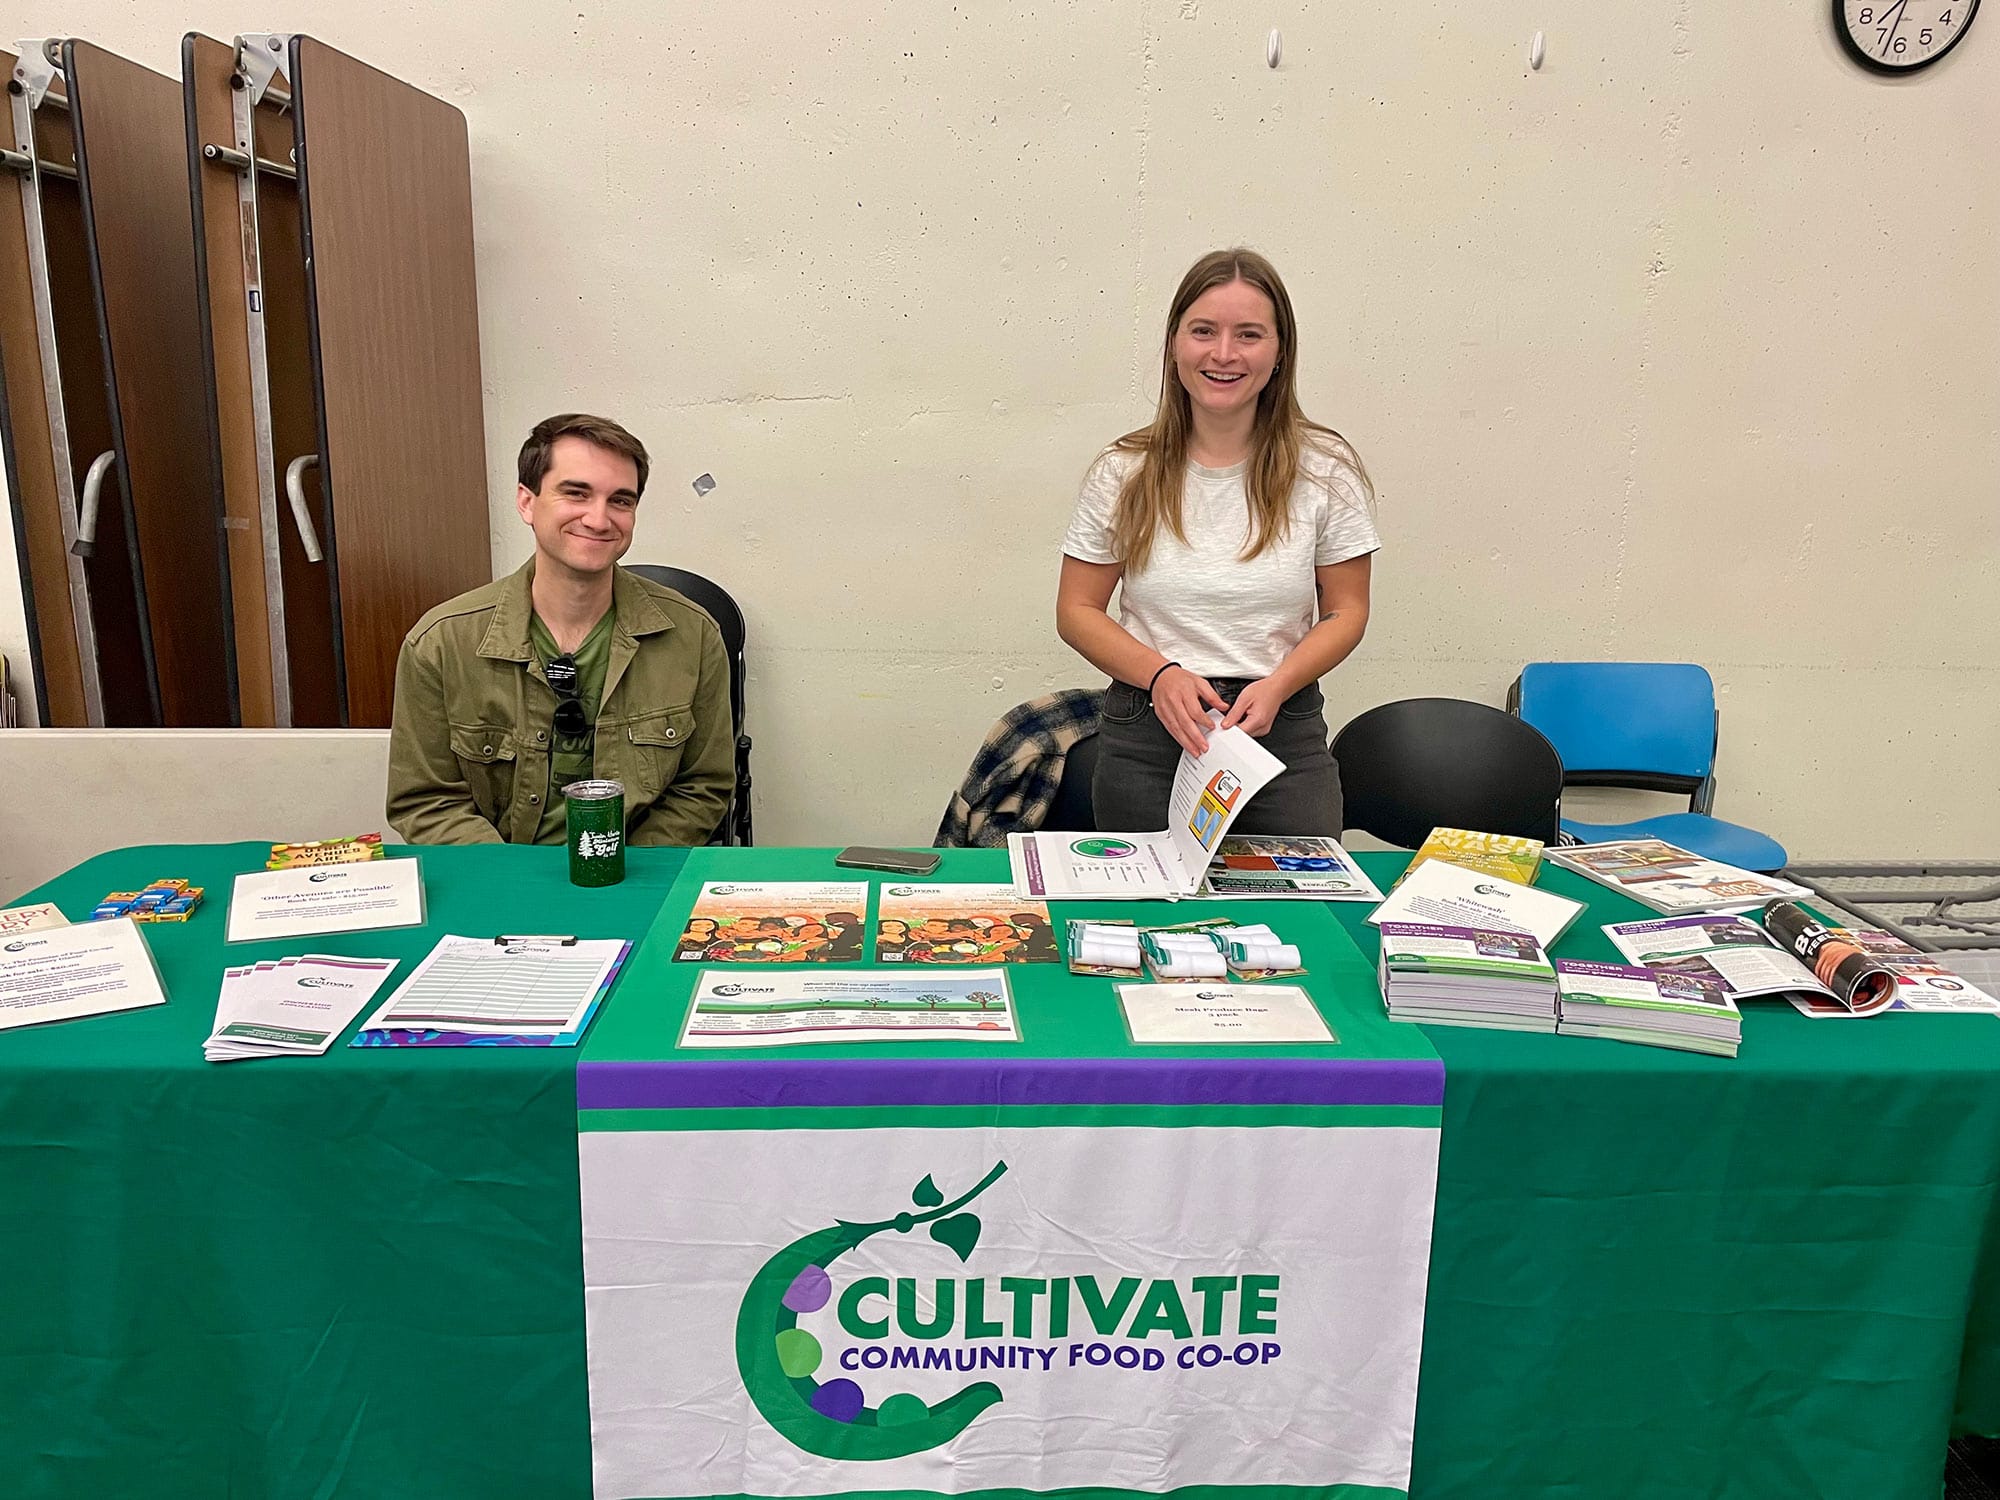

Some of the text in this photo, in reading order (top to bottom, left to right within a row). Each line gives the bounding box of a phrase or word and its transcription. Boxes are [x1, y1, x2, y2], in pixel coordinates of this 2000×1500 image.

[1859, 8, 1873, 25] 8
[1939, 9, 1952, 26] 4
[1876, 28, 1888, 45] 7
[1893, 37, 1907, 53] 6
[1919, 28, 1932, 46] 5
[294, 847, 360, 860] AVENUES
[1429, 836, 1539, 857] WASH
[1562, 961, 1623, 971] TOGETHER
[837, 1274, 1280, 1340] CULTIVATE
[839, 1342, 1281, 1372] COMMUNITY FOOD CO-OP
